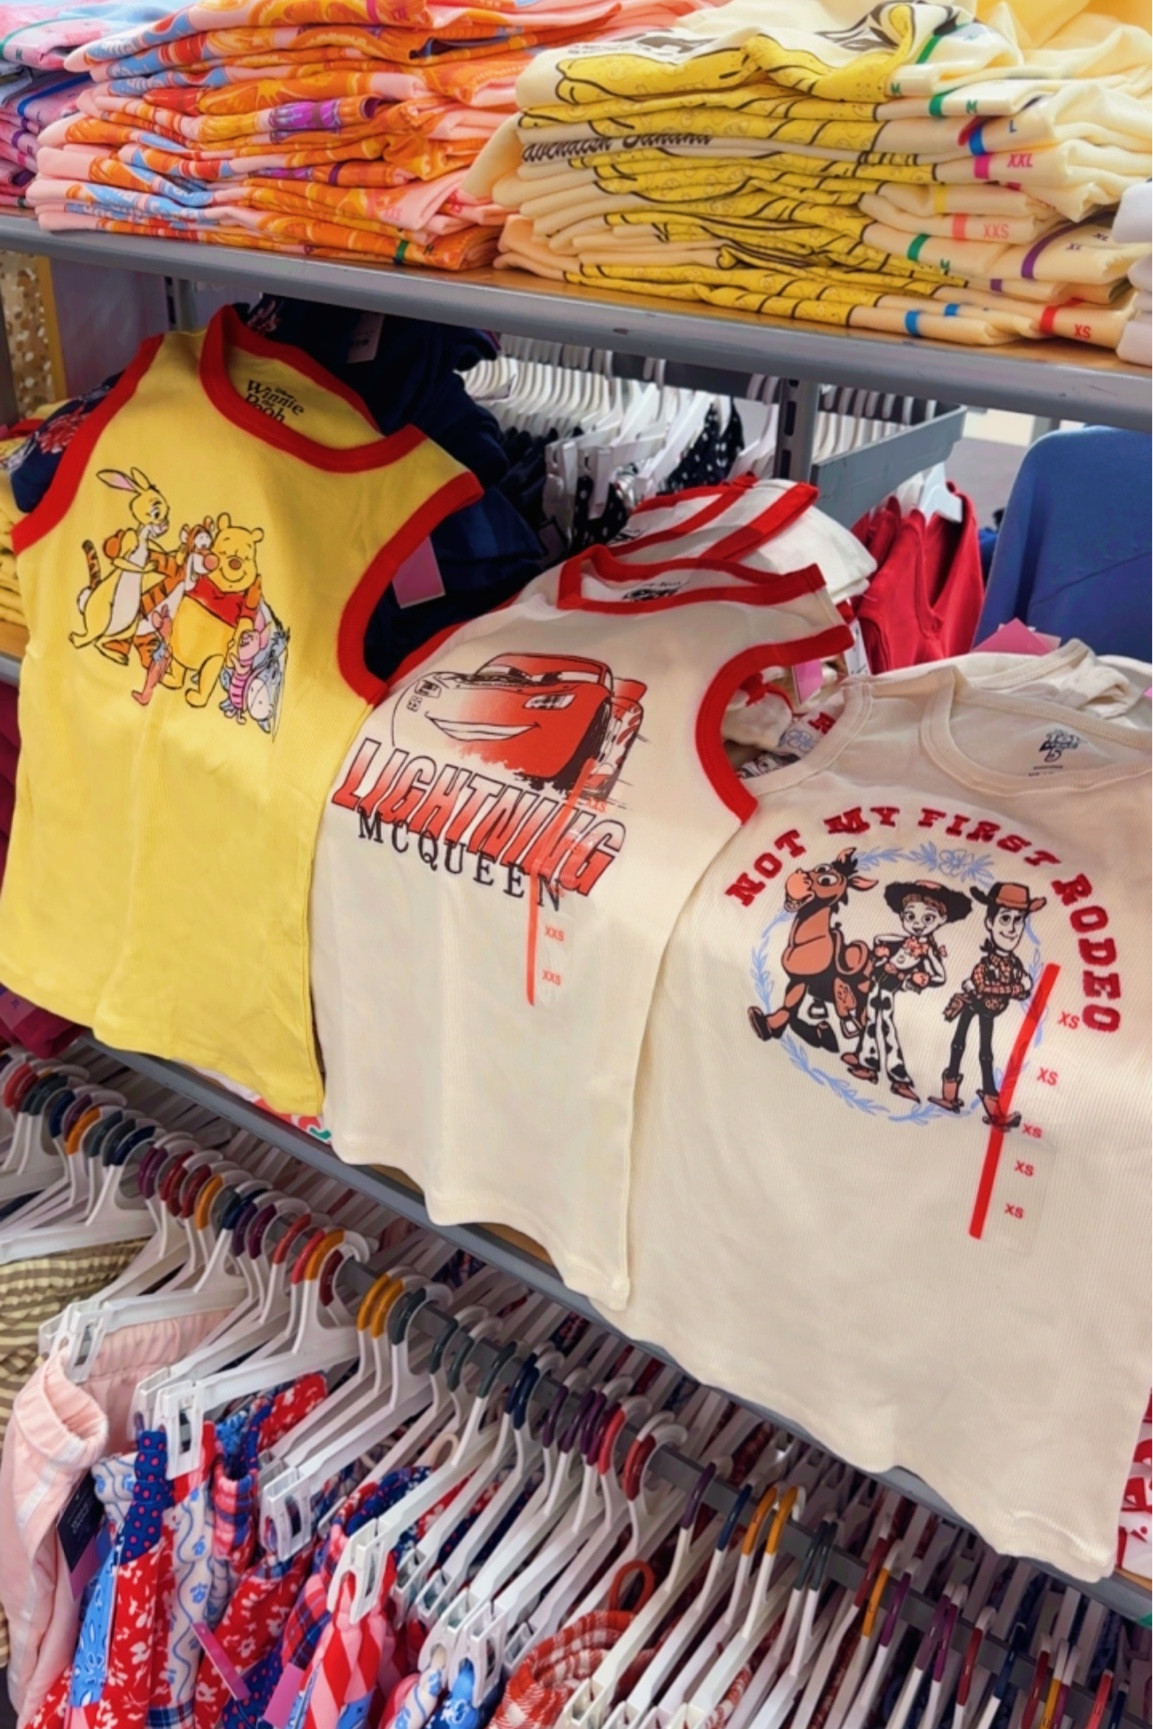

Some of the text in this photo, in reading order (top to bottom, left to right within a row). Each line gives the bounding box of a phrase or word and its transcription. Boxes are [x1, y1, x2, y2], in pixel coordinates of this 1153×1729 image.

[966, 100, 978, 114] M
[1009, 119, 1017, 133] L
[1007, 153, 1033, 168] XXL
[982, 222, 1010, 239] XXS
[1073, 323, 1091, 339] XS
[247, 379, 305, 416] Winnie
[331, 737, 627, 897] LIGHTNING
[357, 804, 561, 912] MCQUEEN
[724, 806, 1122, 1033] NOT MY FIRST RODEO
[544, 925, 565, 942] XXS
[542, 968, 562, 987] XXS
[1058, 1010, 1081, 1031] XS
[1036, 1066, 1059, 1087] XS
[1022, 1123, 1043, 1139] XS
[1014, 1159, 1035, 1177] XS
[1004, 1202, 1024, 1219] XS
